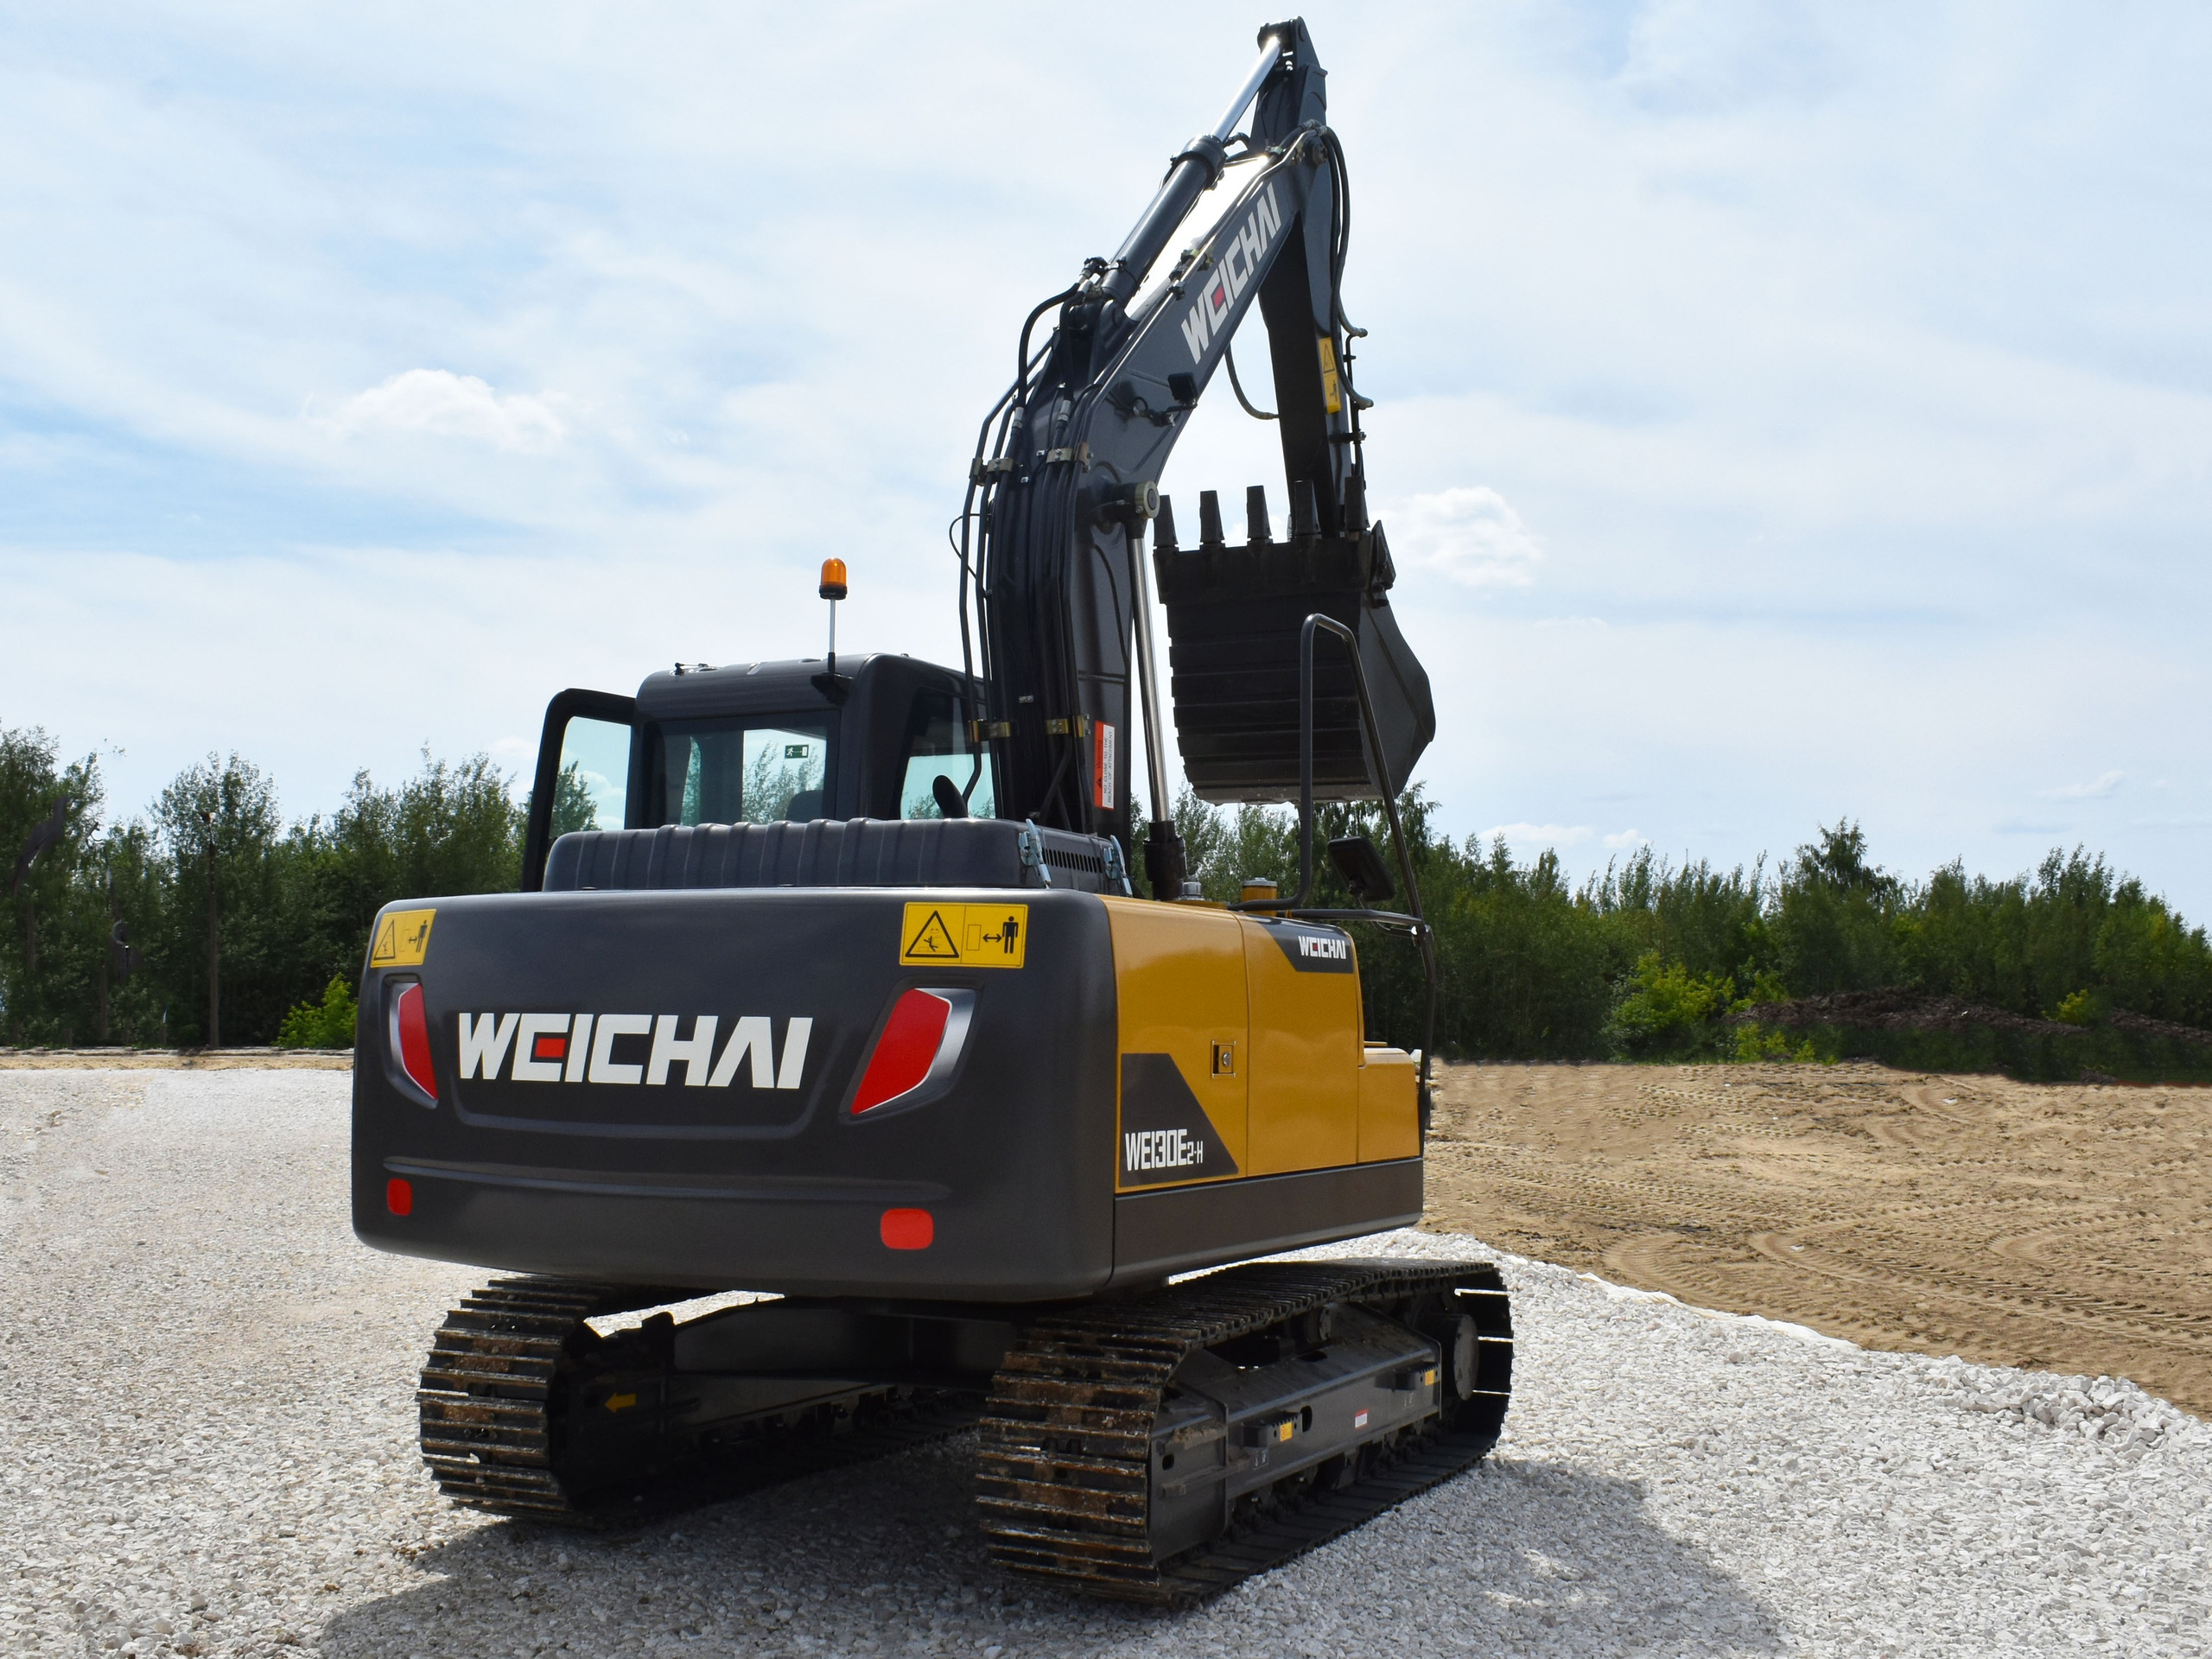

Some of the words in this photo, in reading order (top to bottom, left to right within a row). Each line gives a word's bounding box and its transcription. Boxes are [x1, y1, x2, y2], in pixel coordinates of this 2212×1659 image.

[1180, 181, 1281, 365] WEICHAI
[1298, 935, 1346, 960] WEICHAI
[459, 1013, 813, 1089] WEICHAI
